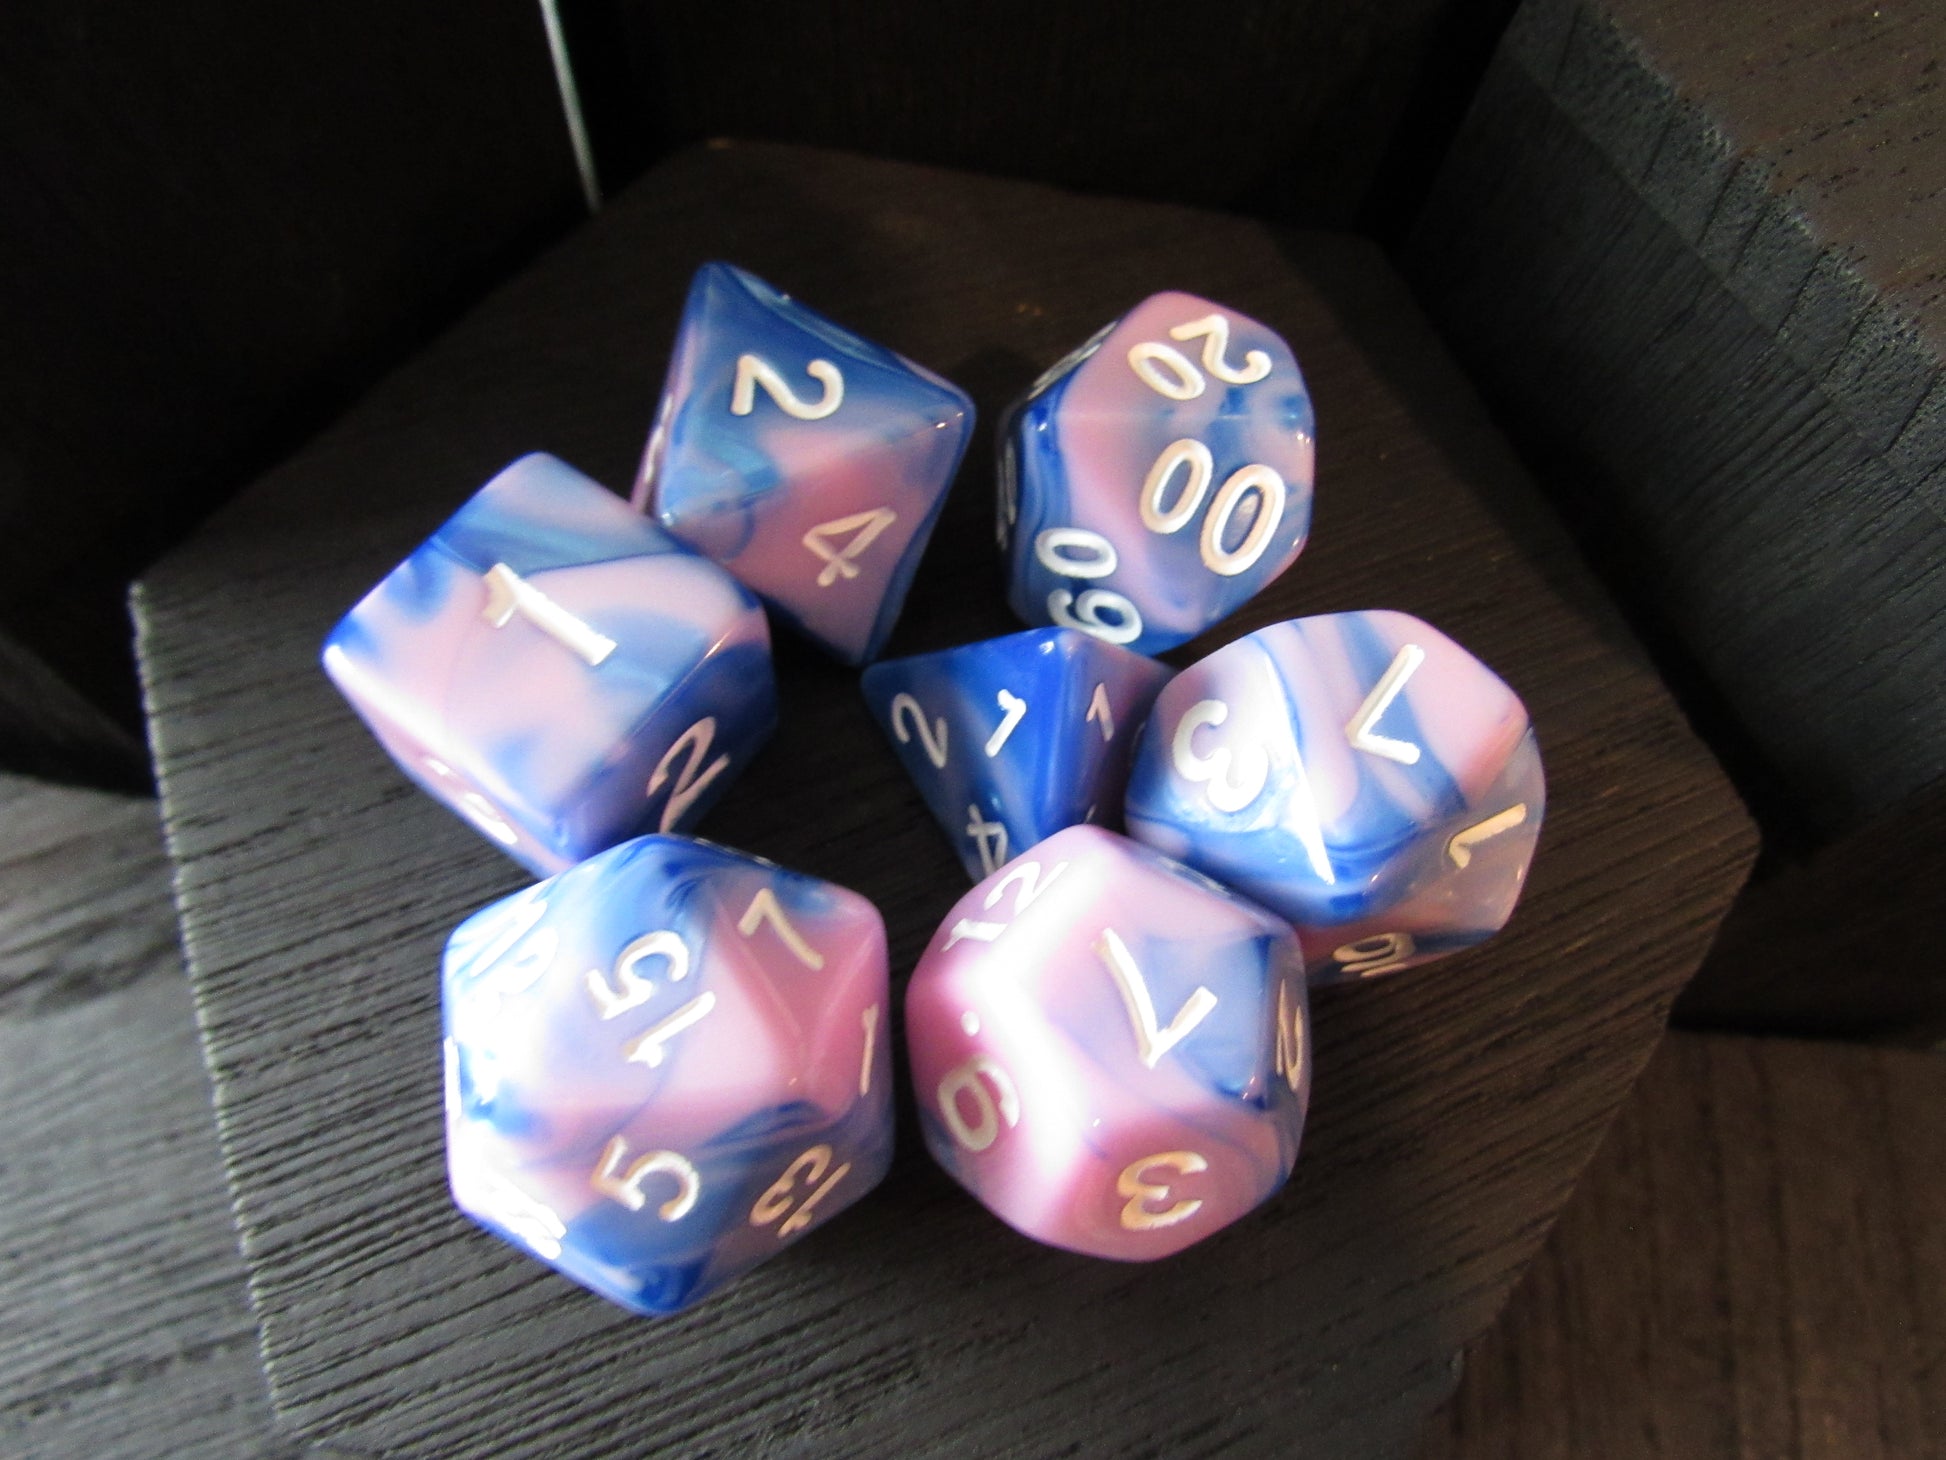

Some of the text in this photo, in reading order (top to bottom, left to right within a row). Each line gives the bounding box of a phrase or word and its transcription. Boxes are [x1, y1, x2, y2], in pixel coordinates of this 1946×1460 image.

[730, 354, 845, 420] 2
[1127, 314, 1272, 401] 20
[802, 506, 898, 587] 4
[1139, 438, 1286, 576] 00
[481, 562, 617, 666] 1
[892, 692, 948, 769] 2
[984, 688, 1026, 758] 1
[1086, 682, 1115, 742] 1
[1345, 644, 1425, 765] 7
[646, 717, 731, 834] 2
[1171, 699, 1270, 813] 3
[966, 803, 1009, 877] 4
[1448, 802, 1527, 869] 1
[738, 888, 824, 971] 7
[942, 861, 1069, 953] 12
[586, 931, 715, 1068] 15
[1091, 928, 1218, 1069] 7
[590, 1134, 700, 1222] 5
[748, 1144, 851, 1239] 13
[1117, 1150, 1208, 1231] 3
